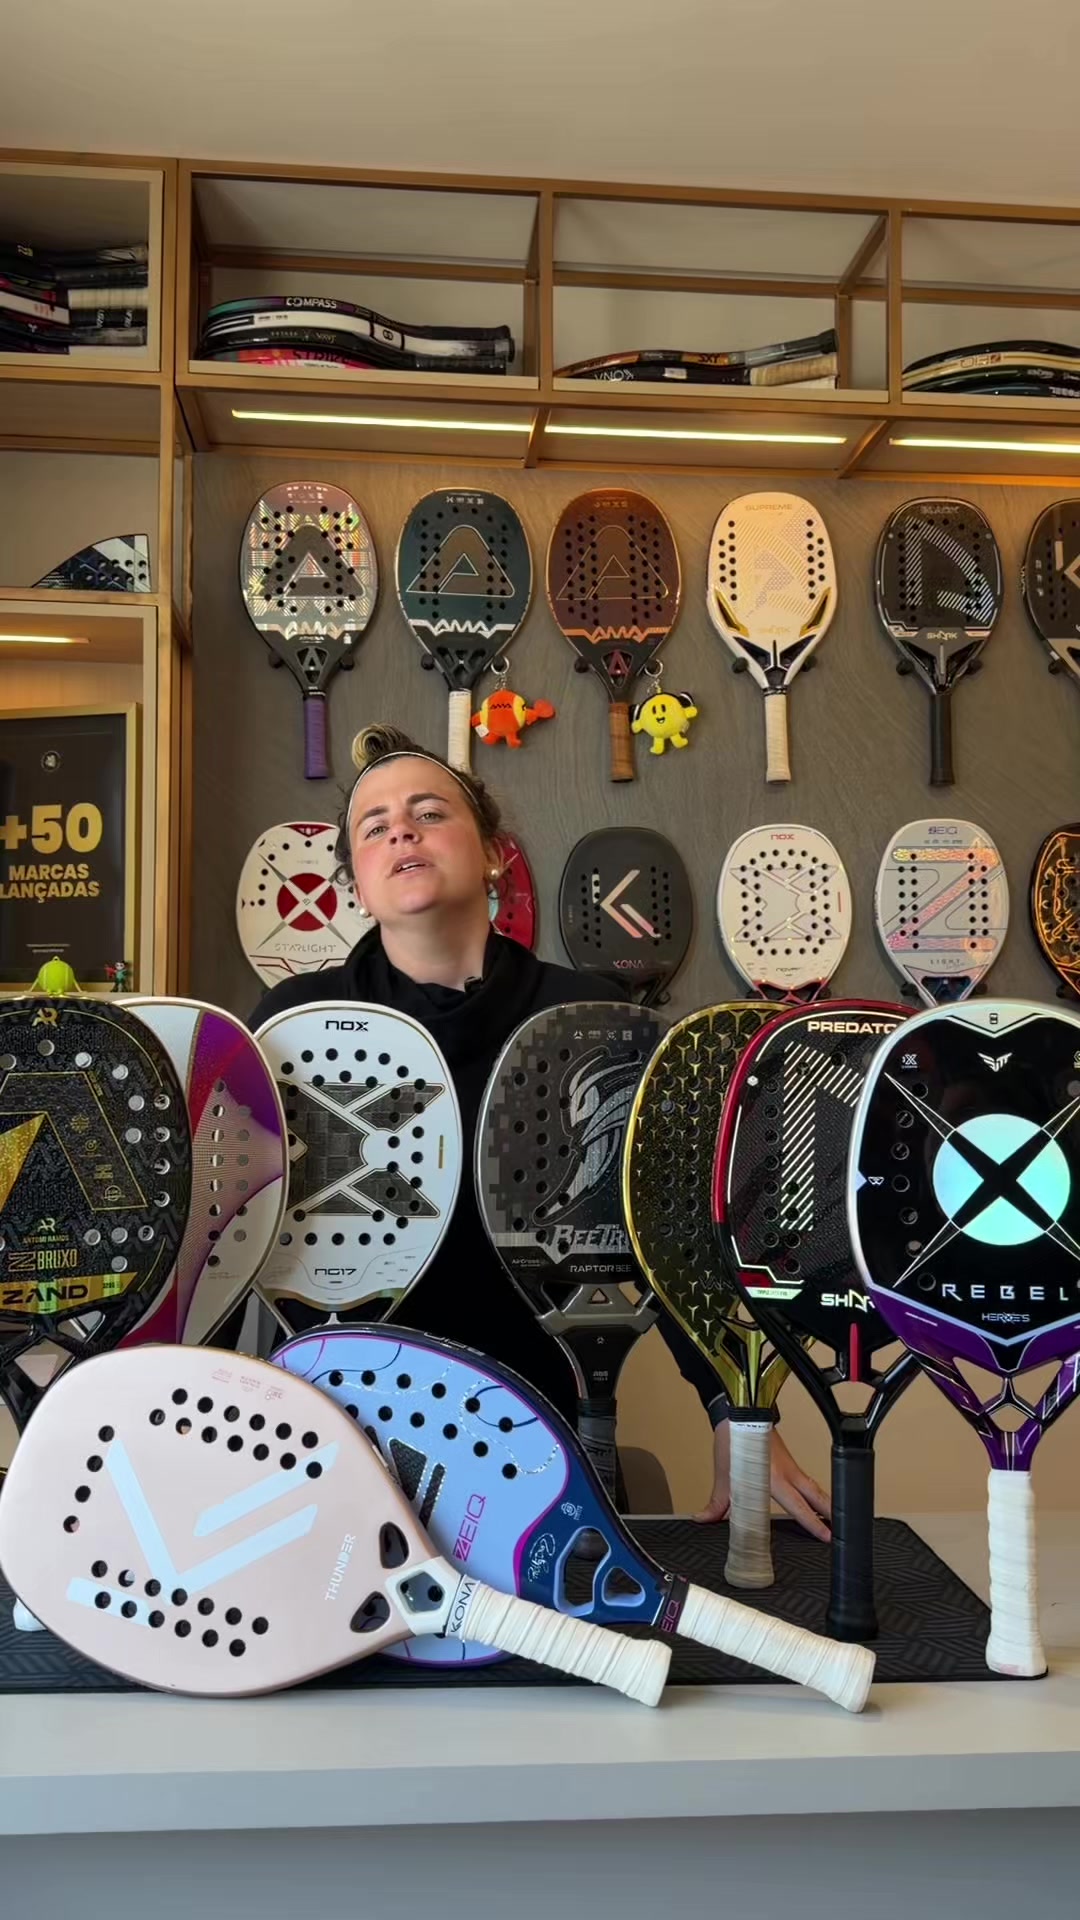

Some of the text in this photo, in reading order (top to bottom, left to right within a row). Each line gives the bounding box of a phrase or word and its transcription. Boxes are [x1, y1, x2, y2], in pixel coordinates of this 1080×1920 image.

[286, 297, 337, 309] COMPASS
[745, 503, 793, 512] SUPREME
[0, 802, 103, 854] +50
[8, 863, 90, 881] MARCAS
[0, 881, 100, 904] LANÇADAS
[274, 943, 337, 954] STARLIGHT
[613, 960, 644, 969] KONA
[37, 1248, 78, 1271] BRUXO
[569, 1264, 615, 1273] RAPTOR
[2, 1284, 89, 1305] ZAND
[941, 1283, 1069, 1301] REBEL
[452, 1493, 487, 1562] ZEIQ
[324, 1533, 357, 1601] THUNDER
[450, 1580, 476, 1633] KONA
